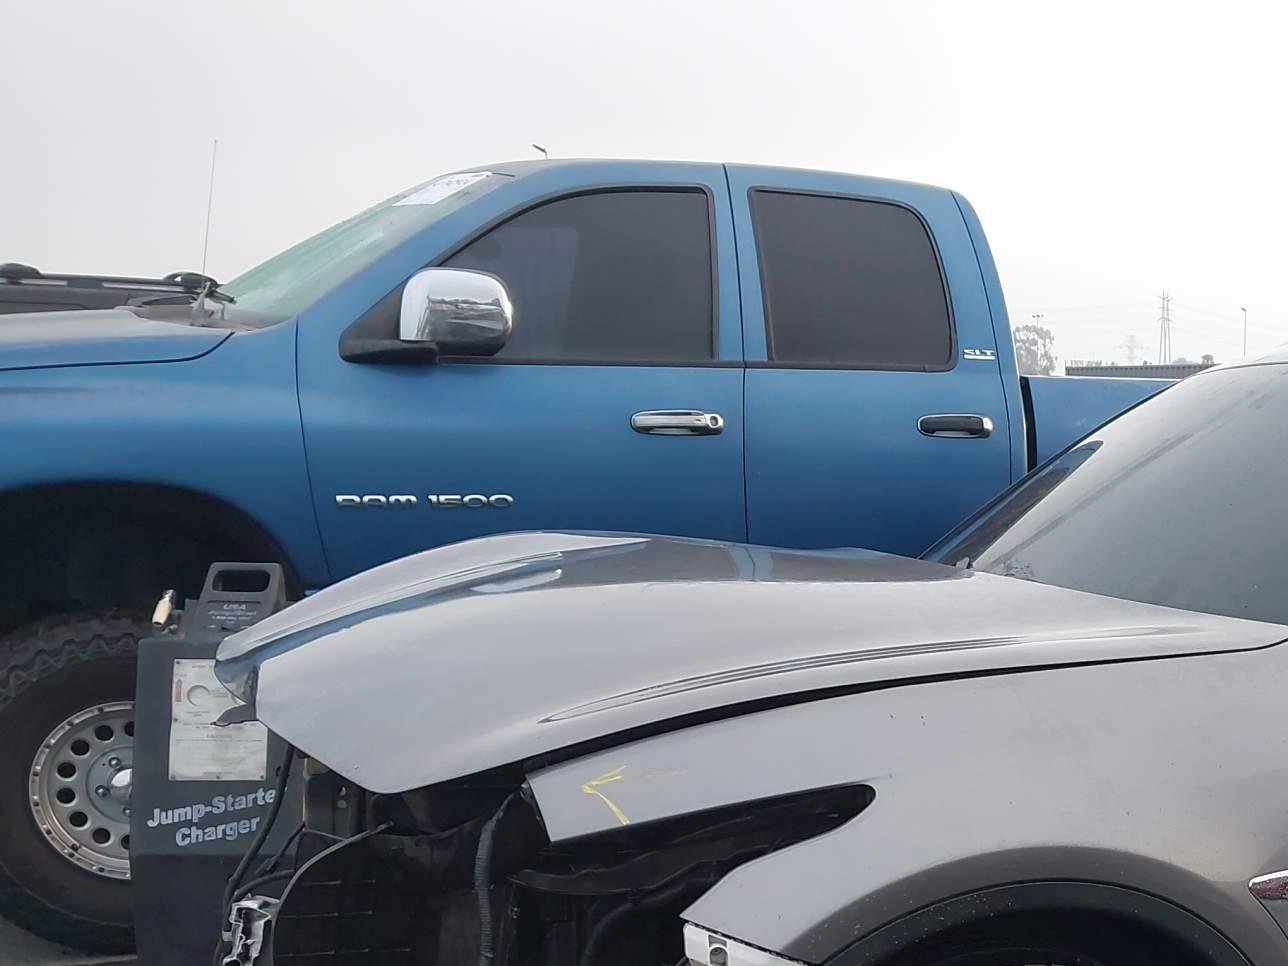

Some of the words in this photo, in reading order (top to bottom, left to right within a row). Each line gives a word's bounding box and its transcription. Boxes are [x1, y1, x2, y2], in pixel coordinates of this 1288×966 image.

[963, 348, 995, 356] SLT
[335, 494, 417, 508] RAM
[428, 494, 514, 508] 1500
[146, 787, 279, 828] Jump-Starte
[175, 816, 260, 847] Charger
